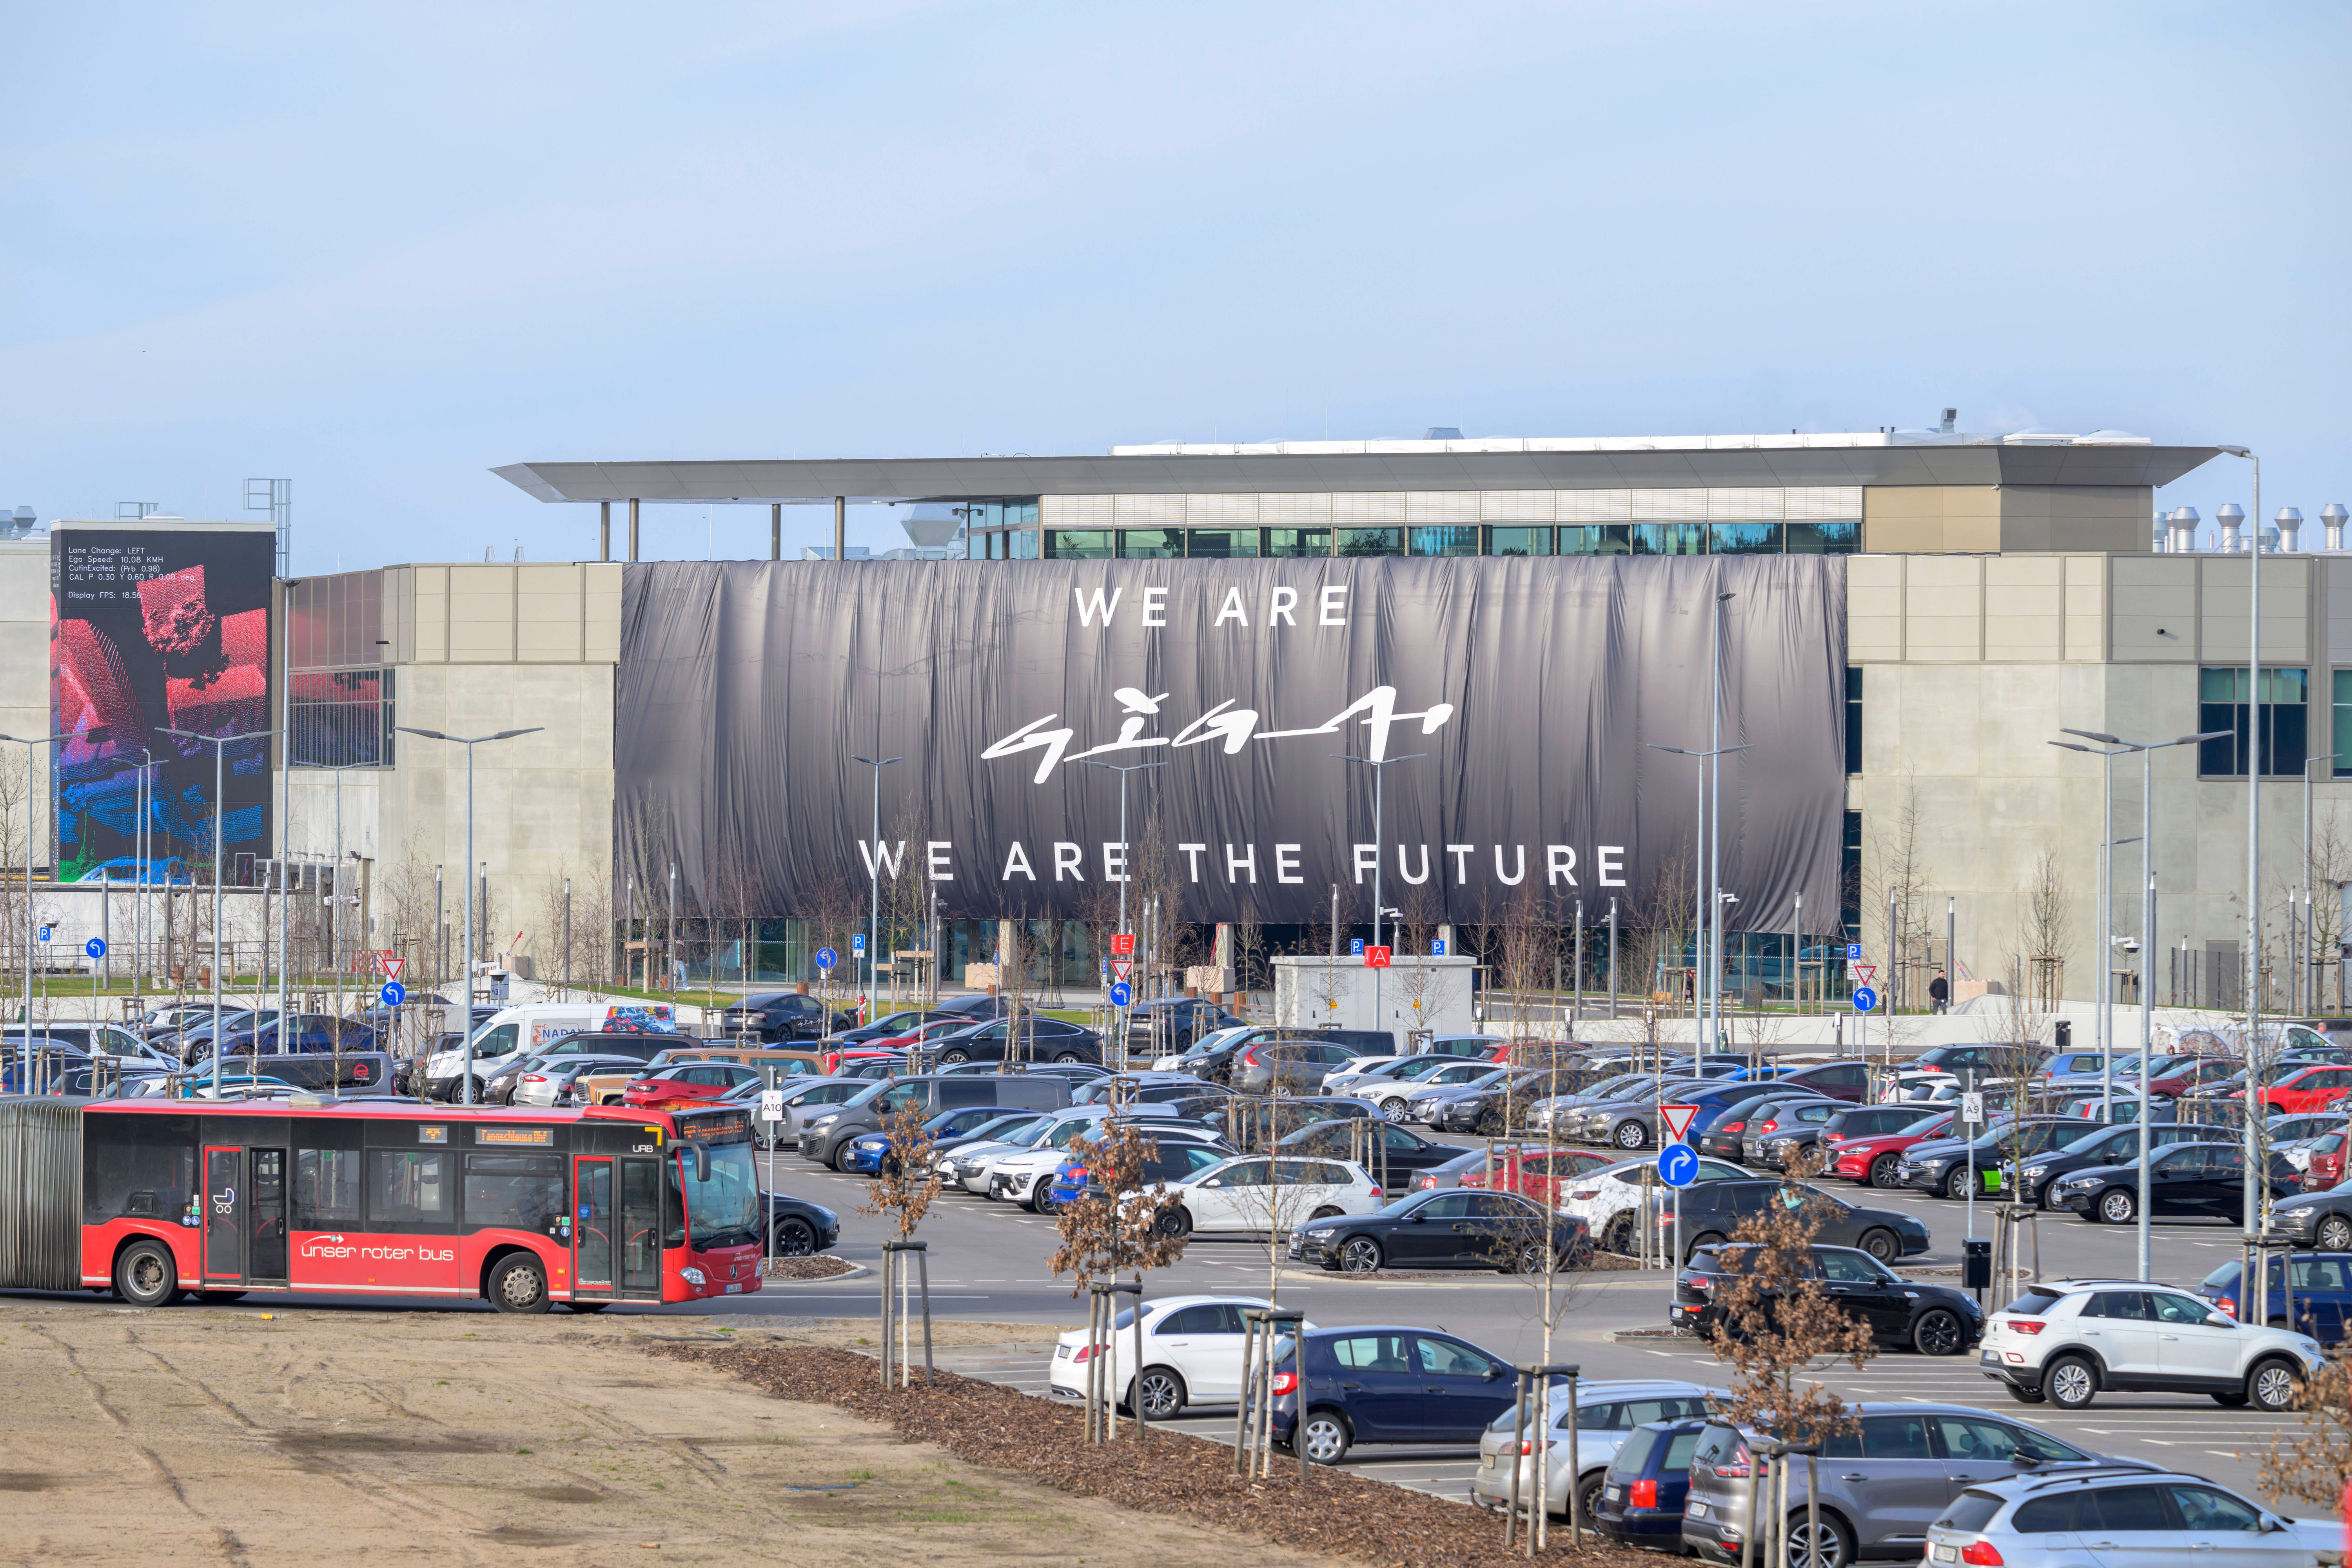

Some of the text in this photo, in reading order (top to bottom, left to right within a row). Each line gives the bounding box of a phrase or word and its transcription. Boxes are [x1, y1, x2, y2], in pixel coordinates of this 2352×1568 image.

[91, 547, 122, 555] Change:
[69, 555, 83, 564] Ego
[87, 556, 113, 564] Speed:
[121, 564, 136, 573] (Prb
[141, 564, 160, 573] 0.98)
[68, 591, 95, 600] Display
[1074, 586, 1347, 627] WE ARE
[858, 840, 1626, 887] WE ARE THE FUTURE
[41, 929, 47, 940] P
[855, 936, 861, 947] P
[1120, 937, 1129, 950] E
[1353, 941, 1360, 953] P
[1434, 942, 1441, 953] P
[1849, 946, 1857, 957] P
[1373, 949, 1386, 963] A
[763, 1103, 782, 1112] A10
[1965, 1105, 1979, 1114] A9
[301, 1245, 454, 1261] unser roter bus
